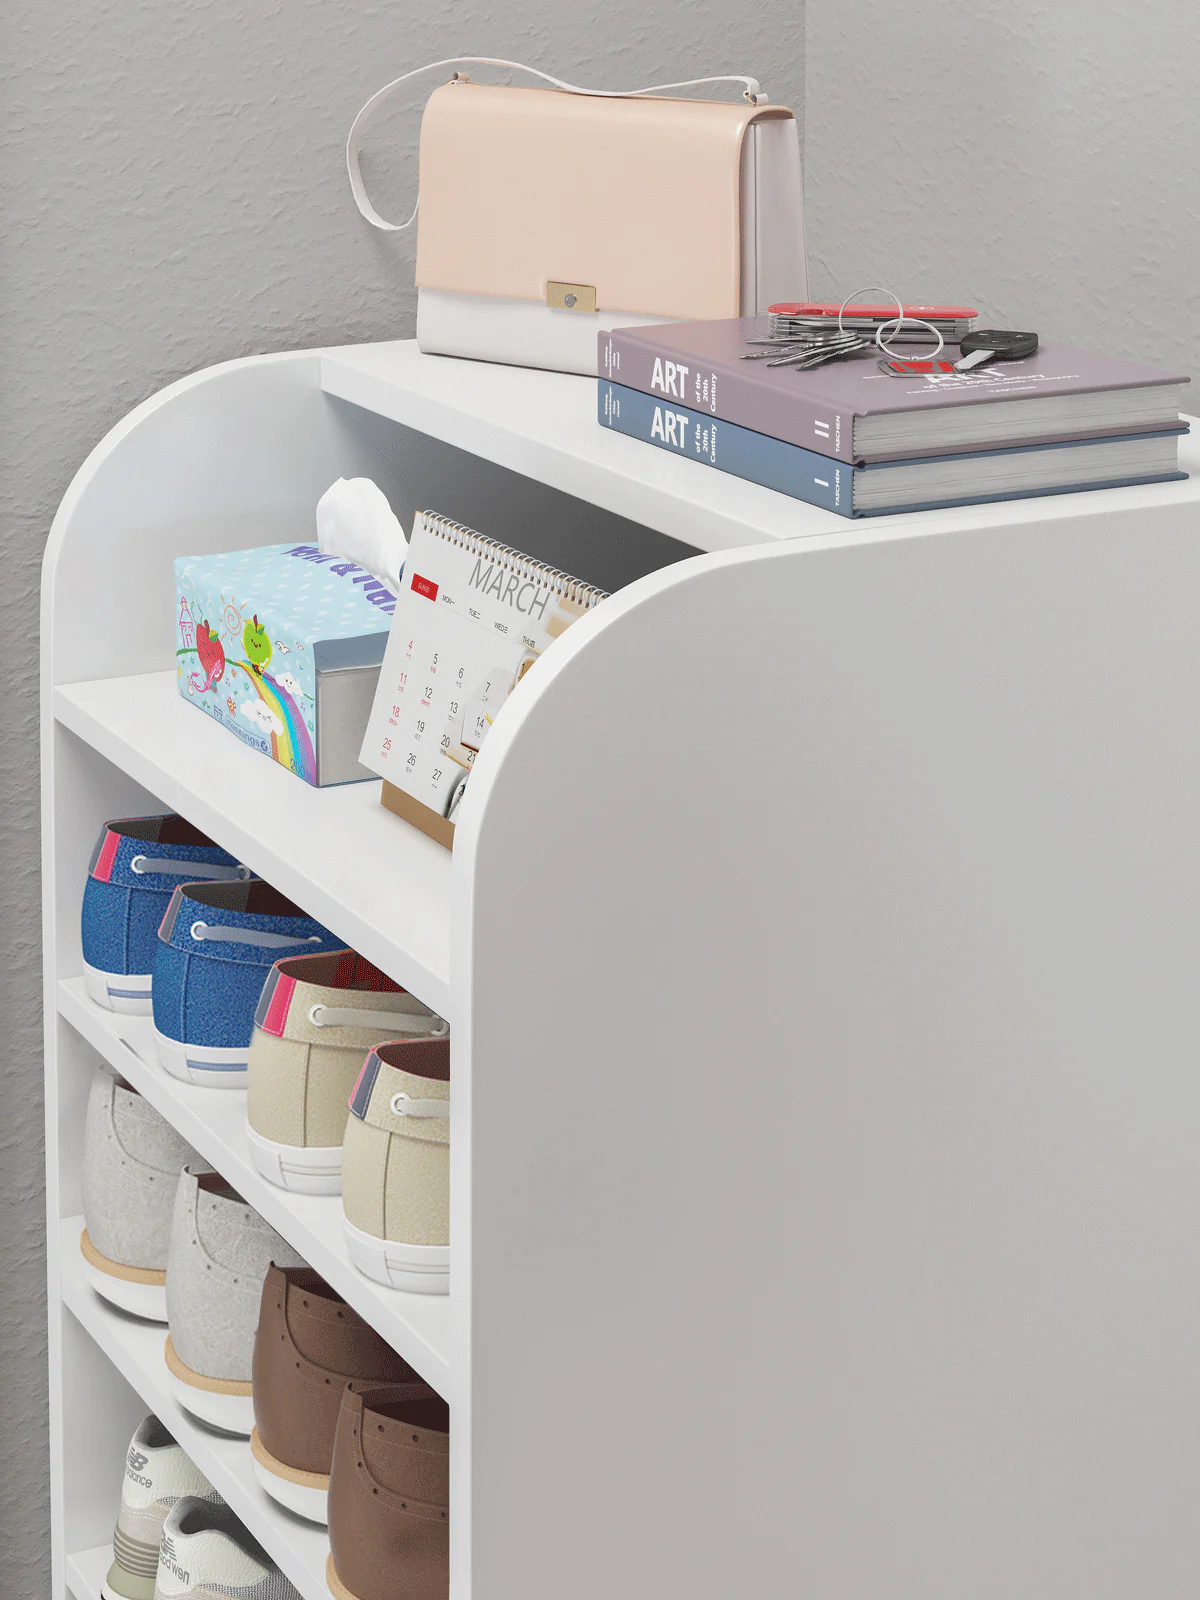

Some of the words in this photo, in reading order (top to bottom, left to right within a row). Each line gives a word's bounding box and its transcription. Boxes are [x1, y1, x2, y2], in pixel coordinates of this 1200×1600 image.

[650, 357, 689, 399] ART
[694, 388, 702, 403] of
[710, 372, 718, 413] Century
[650, 406, 689, 449] ART
[694, 438, 702, 453] of
[710, 423, 718, 463] Century
[468, 558, 551, 621] MARCH
[407, 640, 414, 650] 4
[432, 653, 439, 665] 5
[458, 667, 465, 679] 6
[484, 681, 492, 693] 7
[399, 672, 408, 685] 11
[424, 686, 433, 700] 12
[449, 701, 459, 714] 13
[475, 716, 486, 730] 14
[392, 705, 401, 718] 18
[416, 719, 426, 733] 19
[440, 734, 451, 748] 20
[466, 750, 477, 764] 21
[382, 737, 393, 751] 25
[406, 752, 417, 767] 26
[431, 768, 443, 781] 27
